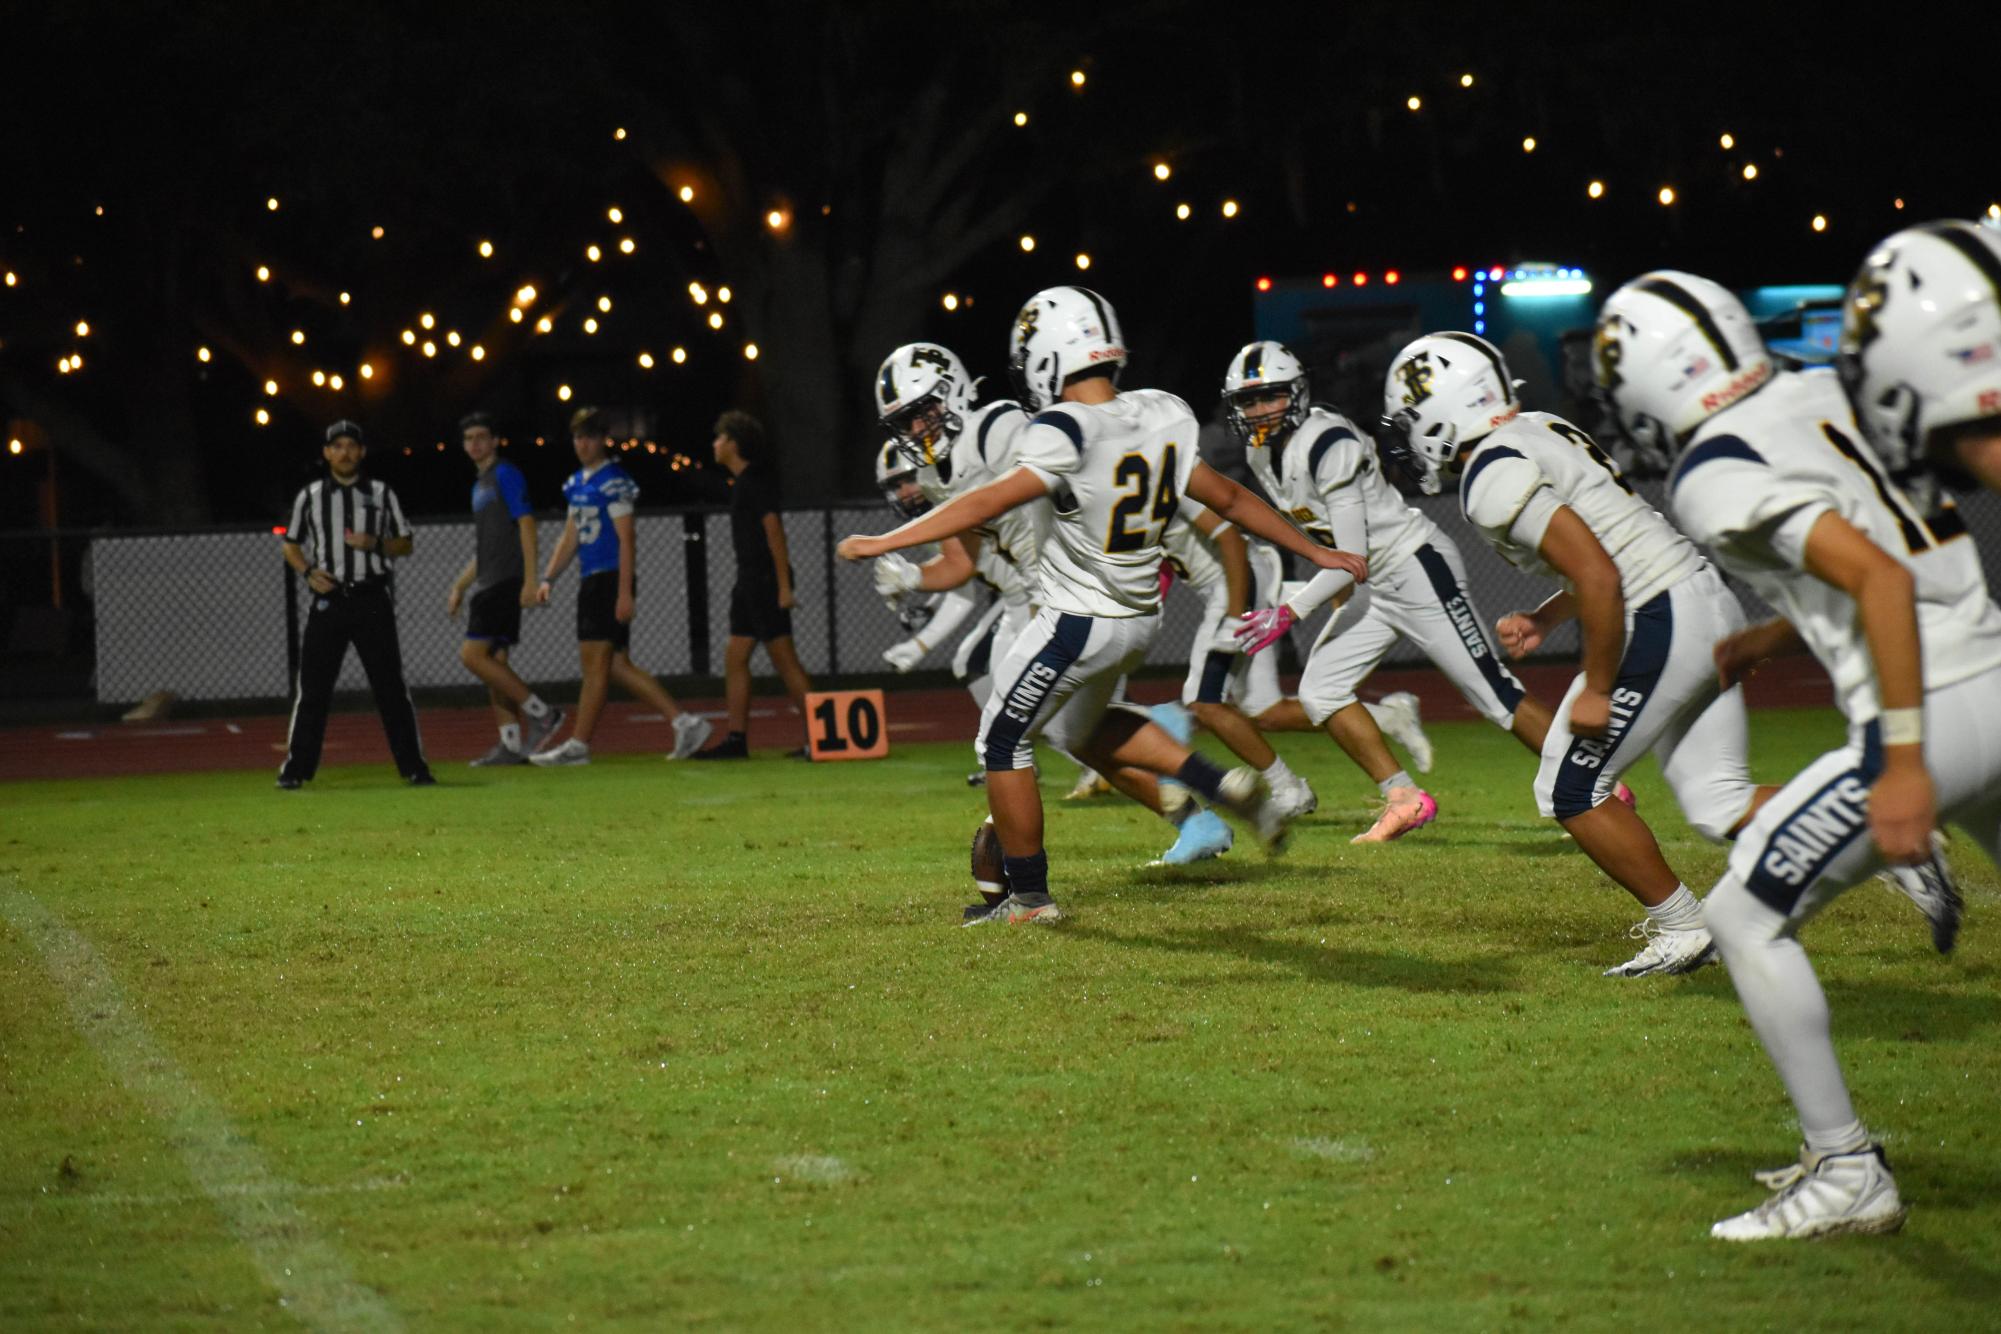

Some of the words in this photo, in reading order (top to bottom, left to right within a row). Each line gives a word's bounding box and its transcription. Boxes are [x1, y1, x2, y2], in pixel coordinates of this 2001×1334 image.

[1104, 442, 1179, 554] 24
[1446, 596, 1488, 658] SAINTS
[814, 697, 879, 752] 10
[1764, 777, 1871, 885] SAINTS
